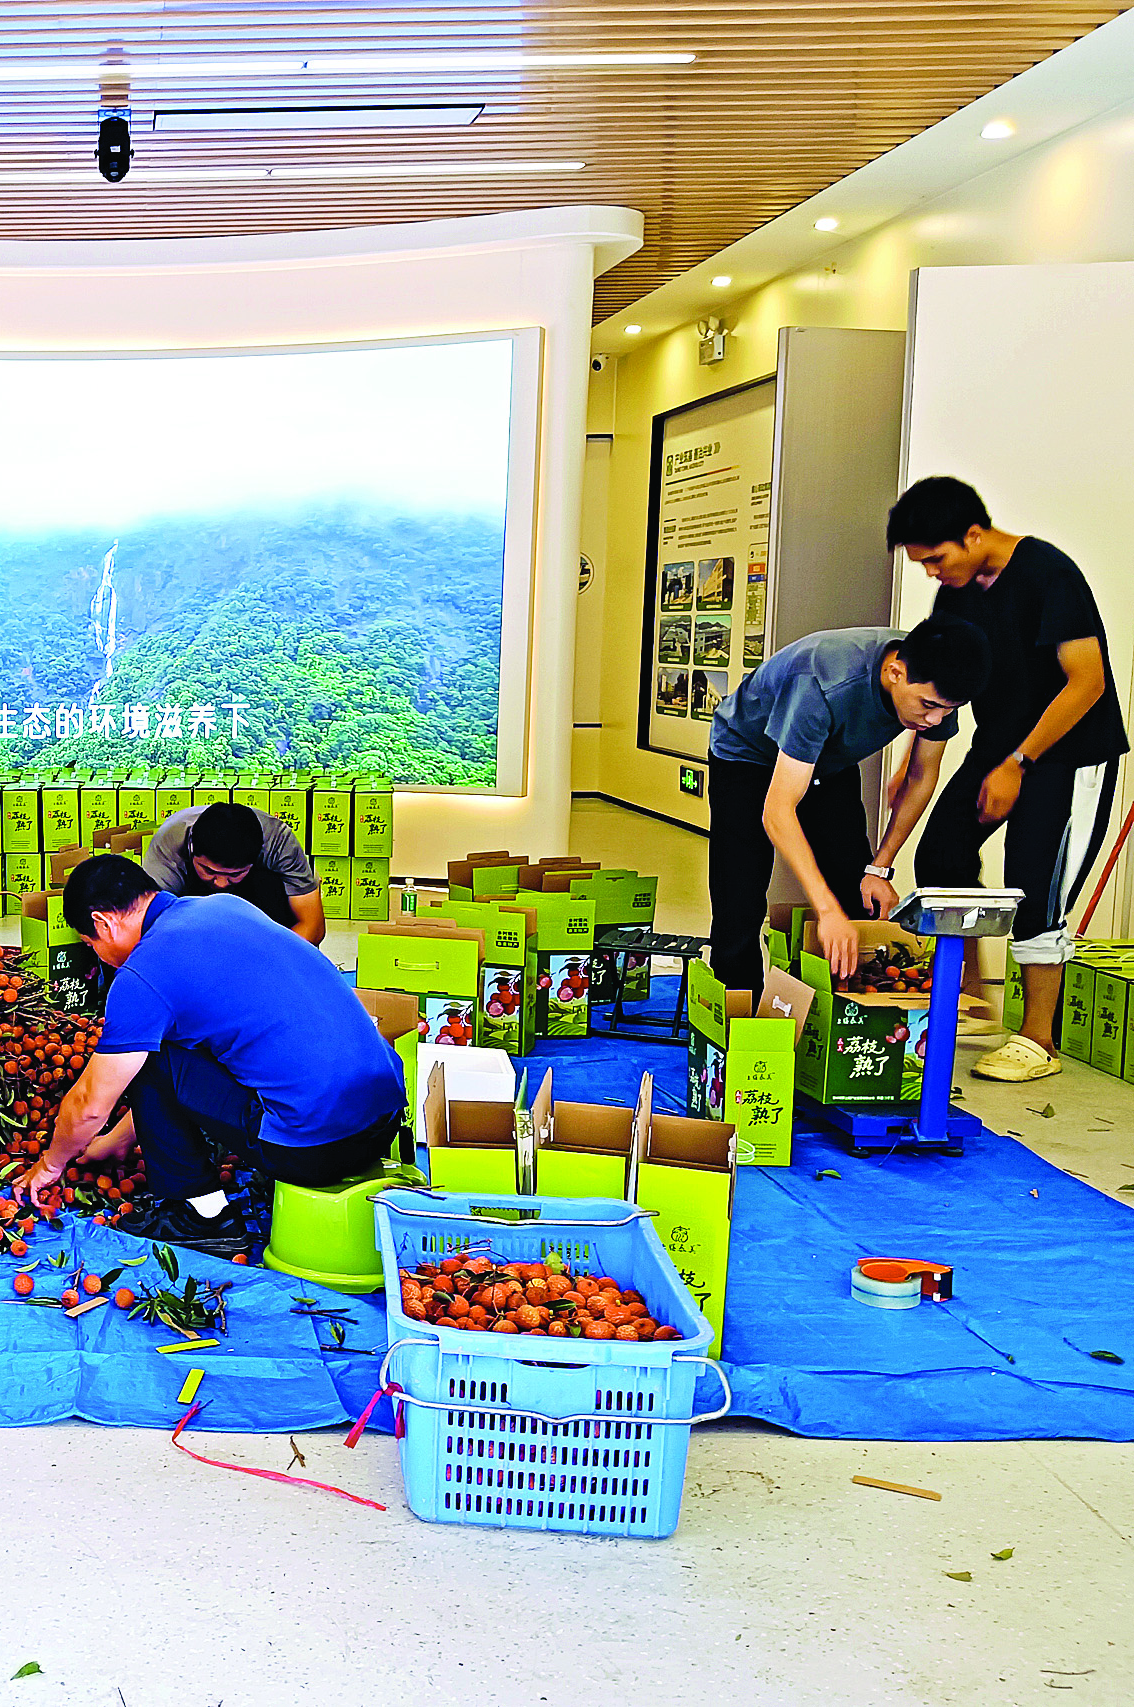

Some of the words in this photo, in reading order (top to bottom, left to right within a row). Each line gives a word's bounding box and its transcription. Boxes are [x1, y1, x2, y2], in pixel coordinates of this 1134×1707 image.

[843, 1036, 885, 1054] 荔枝
[849, 1054, 889, 1078] 熟了
[742, 1090, 779, 1105] 荔枝
[748, 1106, 783, 1126] 熟了
[677, 1268, 705, 1288] 枝
[695, 1293, 711, 1312] 了
